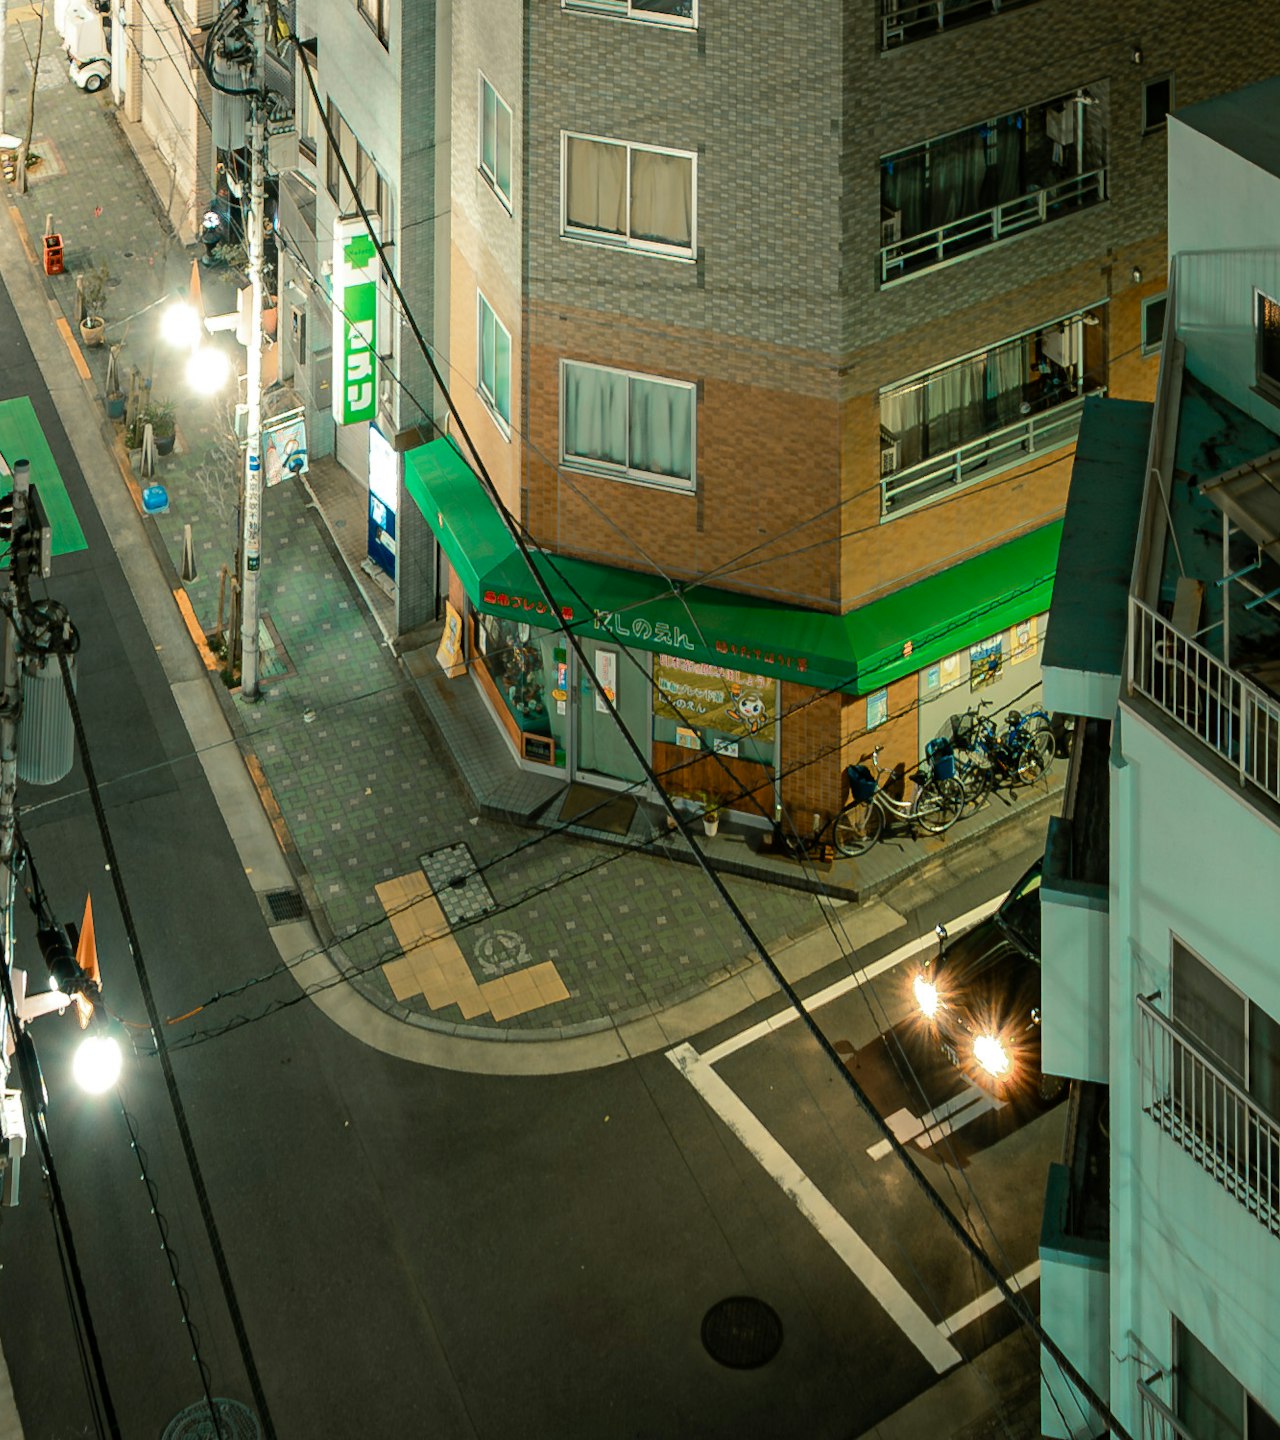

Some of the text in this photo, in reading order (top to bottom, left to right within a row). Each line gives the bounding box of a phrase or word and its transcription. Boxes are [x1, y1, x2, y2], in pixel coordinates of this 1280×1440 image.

[483, 590, 575, 621] 麻布ブレン茶
[593, 608, 695, 652] にしのえん
